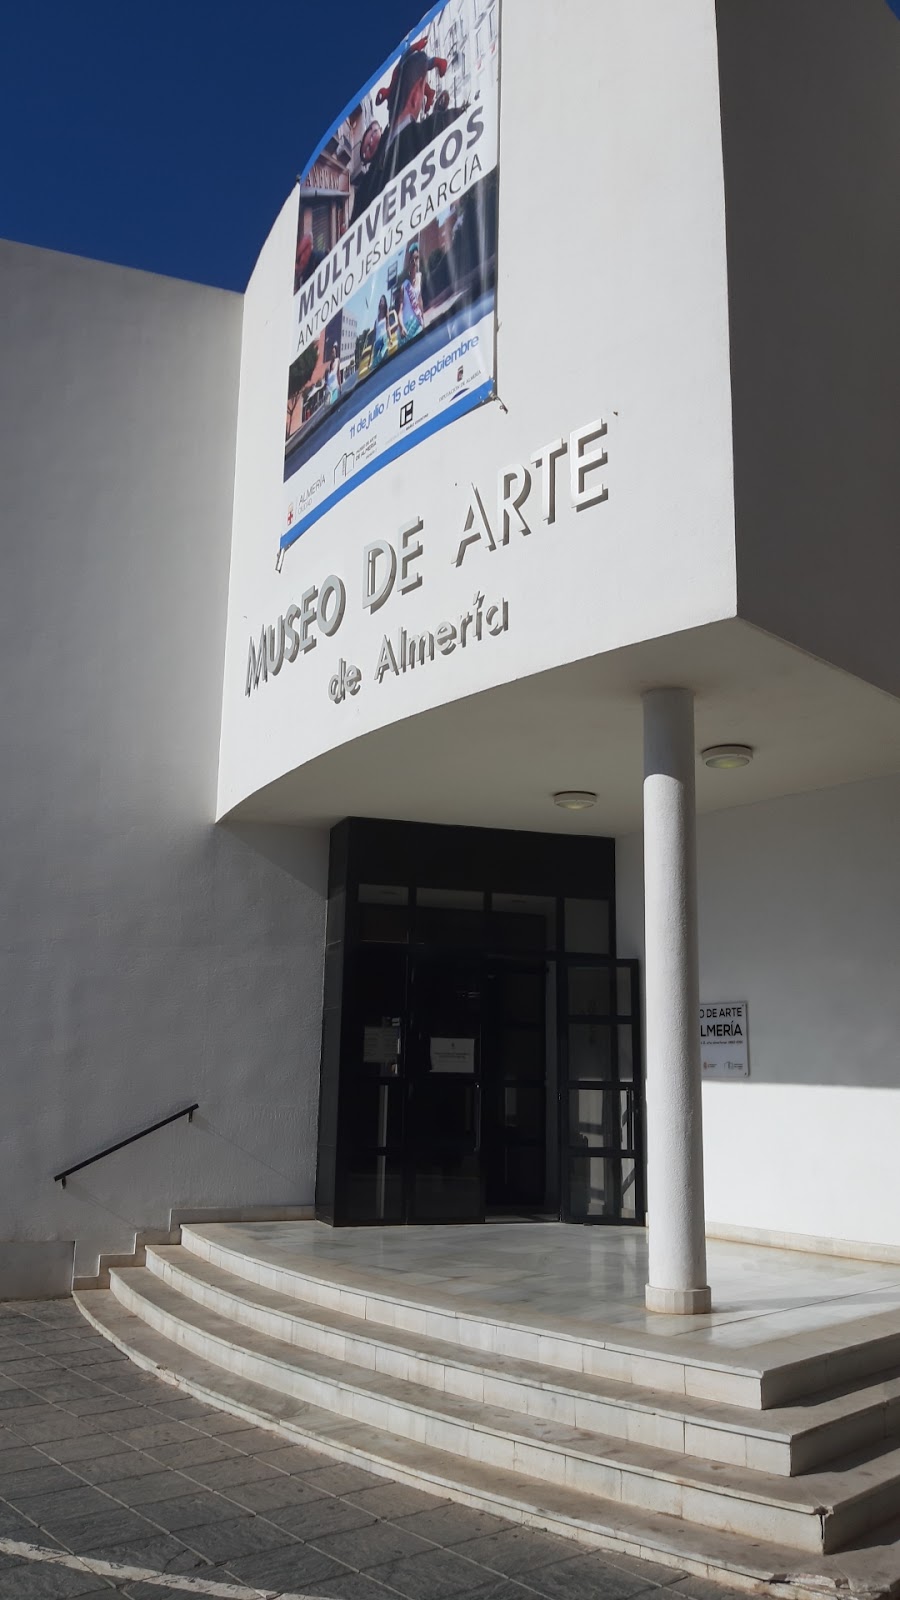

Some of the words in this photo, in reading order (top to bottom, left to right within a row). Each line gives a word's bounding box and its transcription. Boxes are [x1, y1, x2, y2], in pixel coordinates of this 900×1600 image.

[297, 272, 355, 353] ANTONIO
[358, 219, 404, 286] JESÚS
[409, 153, 482, 230] GARCÍA
[298, 105, 485, 325] MULTIVERSOS
[349, 427, 356, 440] 11
[356, 417, 368, 434] de
[365, 403, 385, 430] julio
[391, 389, 402, 405] 15
[403, 379, 416, 398] de
[418, 335, 480, 387] septiembre
[244, 573, 347, 699] MUSEO
[362, 514, 425, 616] DE
[450, 417, 609, 568] ARTE
[327, 657, 362, 705] de
[374, 590, 509, 685] Almería
[700, 1020, 743, 1037] LMERÍA
[706, 1008, 717, 1018] DE
[719, 1007, 743, 1018] ARTE
